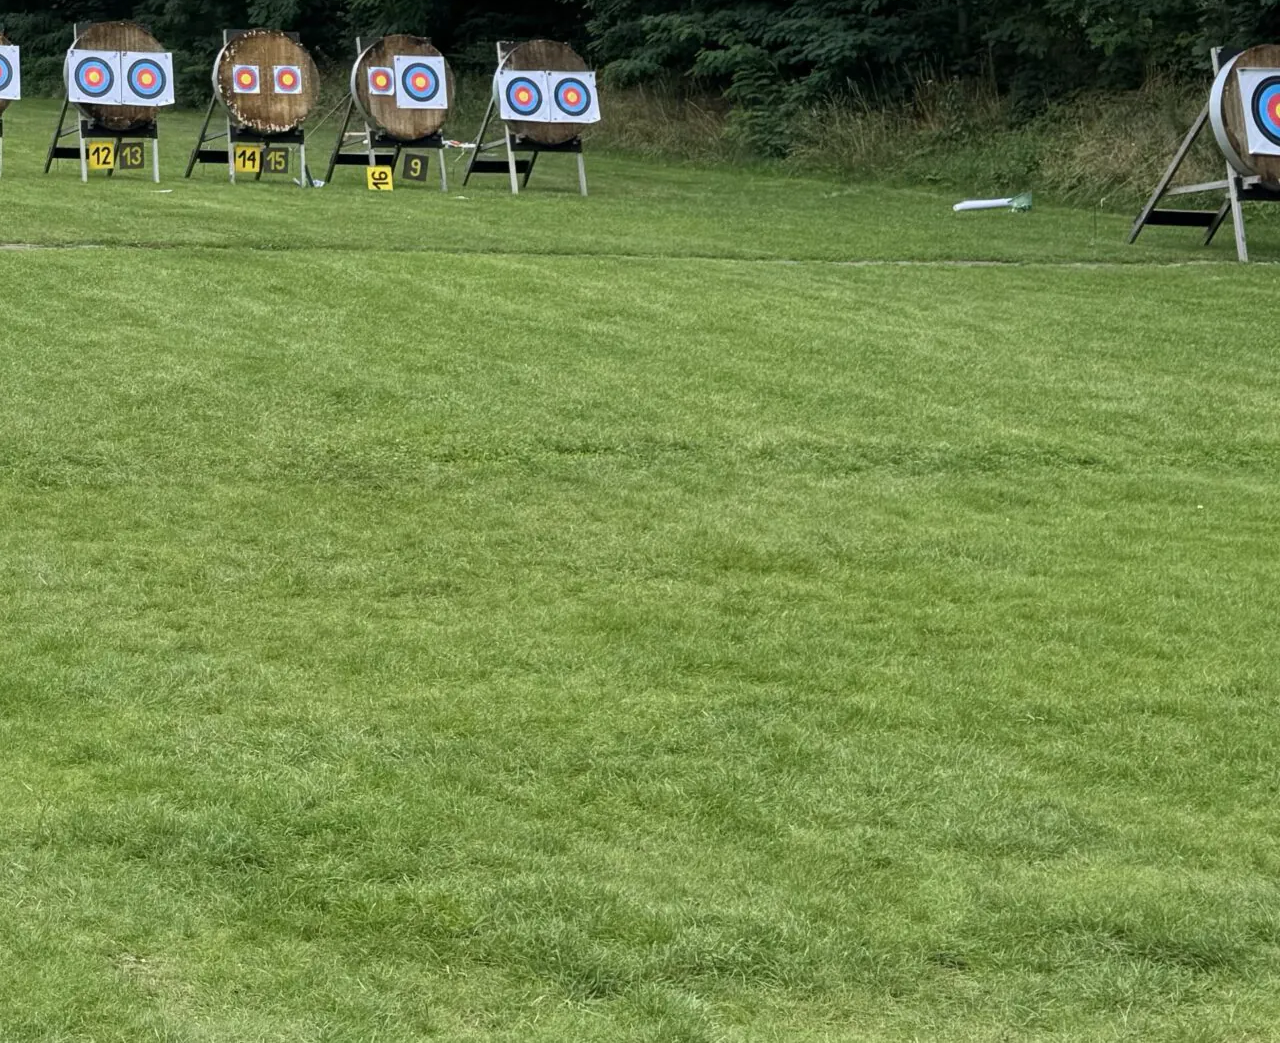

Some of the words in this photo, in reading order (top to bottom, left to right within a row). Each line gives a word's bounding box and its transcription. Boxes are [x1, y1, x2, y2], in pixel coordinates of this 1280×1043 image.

[92, 147, 111, 165] 12
[122, 146, 141, 165] 13
[238, 150, 257, 168] 14
[266, 151, 285, 170] 15
[410, 159, 421, 176] 9
[372, 171, 388, 189] 16
